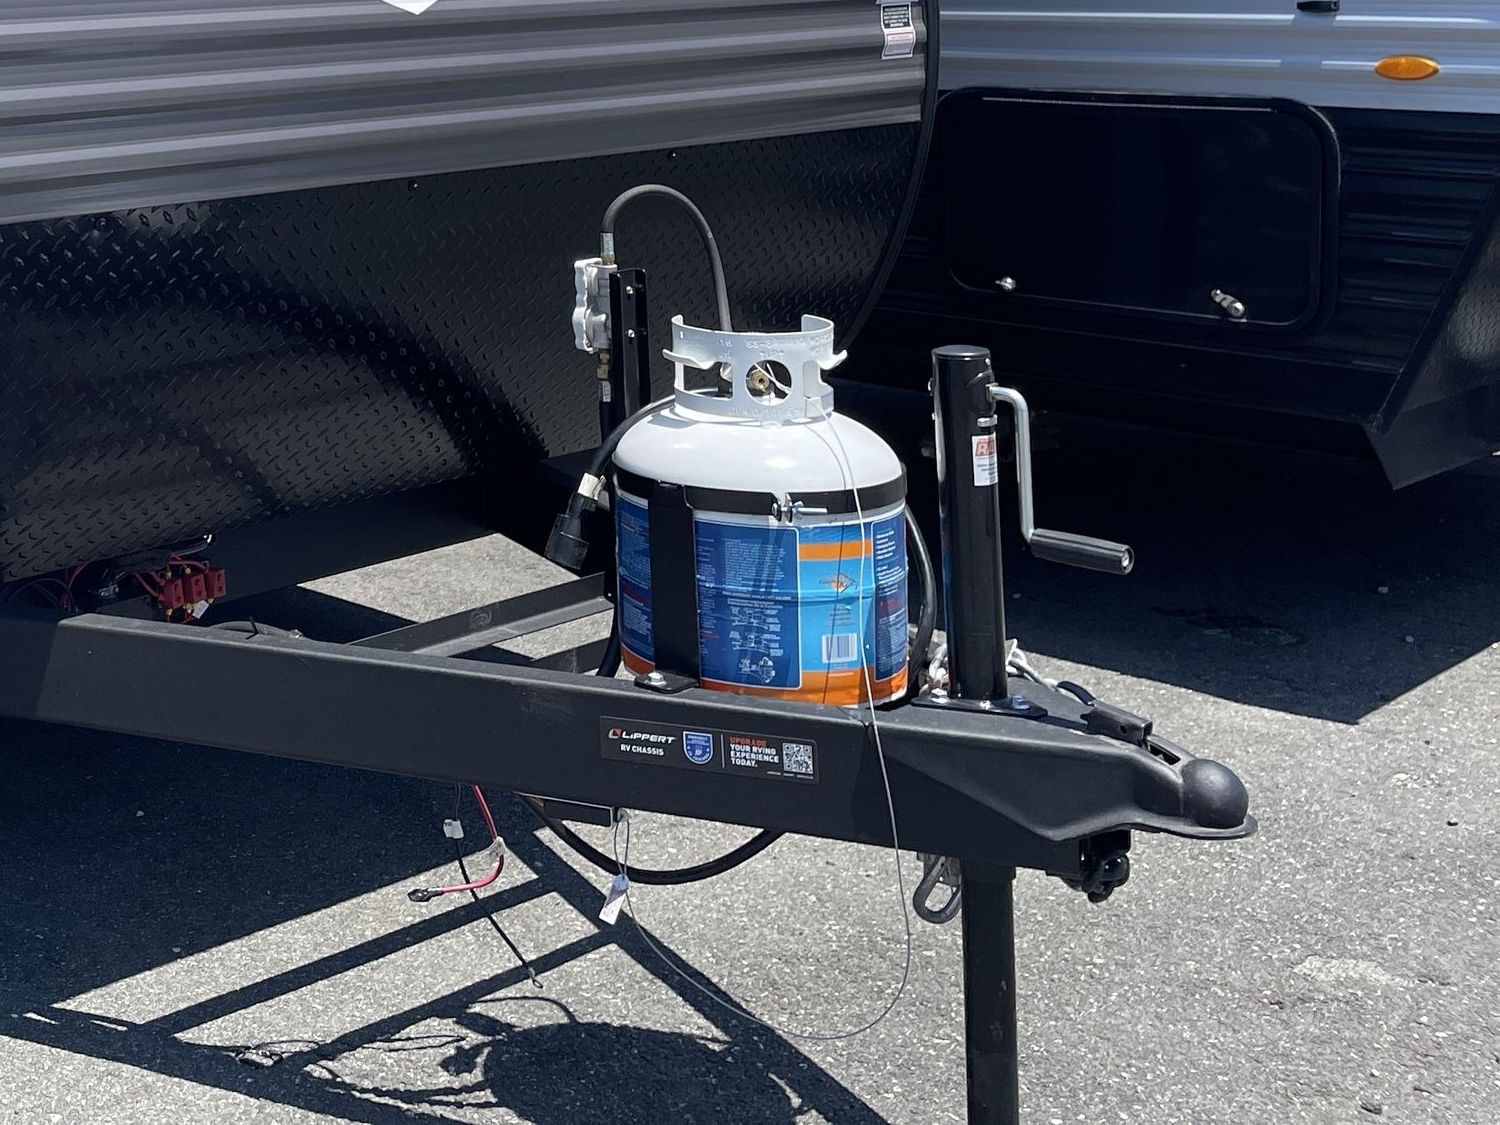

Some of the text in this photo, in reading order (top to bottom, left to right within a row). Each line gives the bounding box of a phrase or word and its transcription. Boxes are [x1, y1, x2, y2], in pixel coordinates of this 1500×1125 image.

[729, 736, 767, 747] UPGRADE
[621, 744, 665, 756] RV CHASSIS
[730, 743, 776, 755] YOUR RVING
[730, 750, 779, 763] EXPERIENCE
[731, 757, 758, 767] TODAY.
